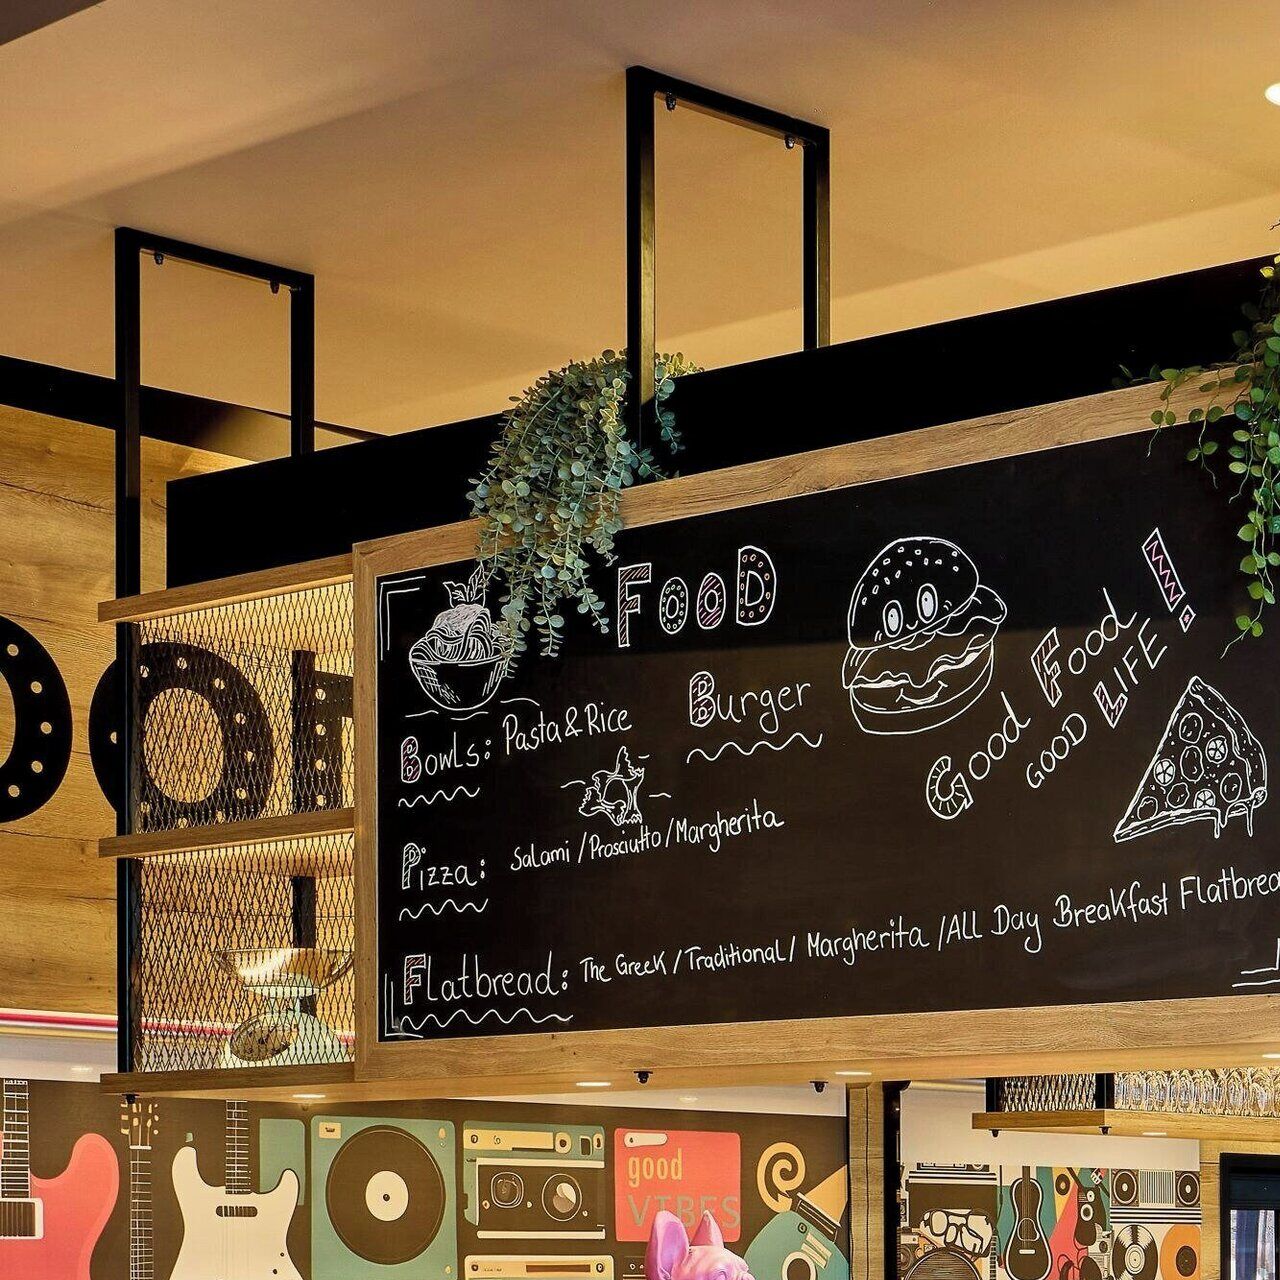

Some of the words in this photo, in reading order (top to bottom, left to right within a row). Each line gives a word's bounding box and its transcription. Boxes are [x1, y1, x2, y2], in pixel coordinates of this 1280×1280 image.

[617, 546, 776, 647] FOOD
[689, 671, 811, 734] Burger
[1026, 712, 1087, 788] GOOD
[1093, 618, 1168, 728] LIFE
[400, 731, 491, 783] Bowls:
[925, 691, 1031, 820] Good
[510, 845, 570, 871] Salami
[404, 951, 569, 1005] Flatbread:
[579, 955, 611, 984] The
[616, 950, 666, 975] Greek
[807, 918, 931, 966] Margherita
[991, 905, 1042, 953] Day
[1054, 881, 1169, 928] Breakfast
[628, 1148, 682, 1188] good
